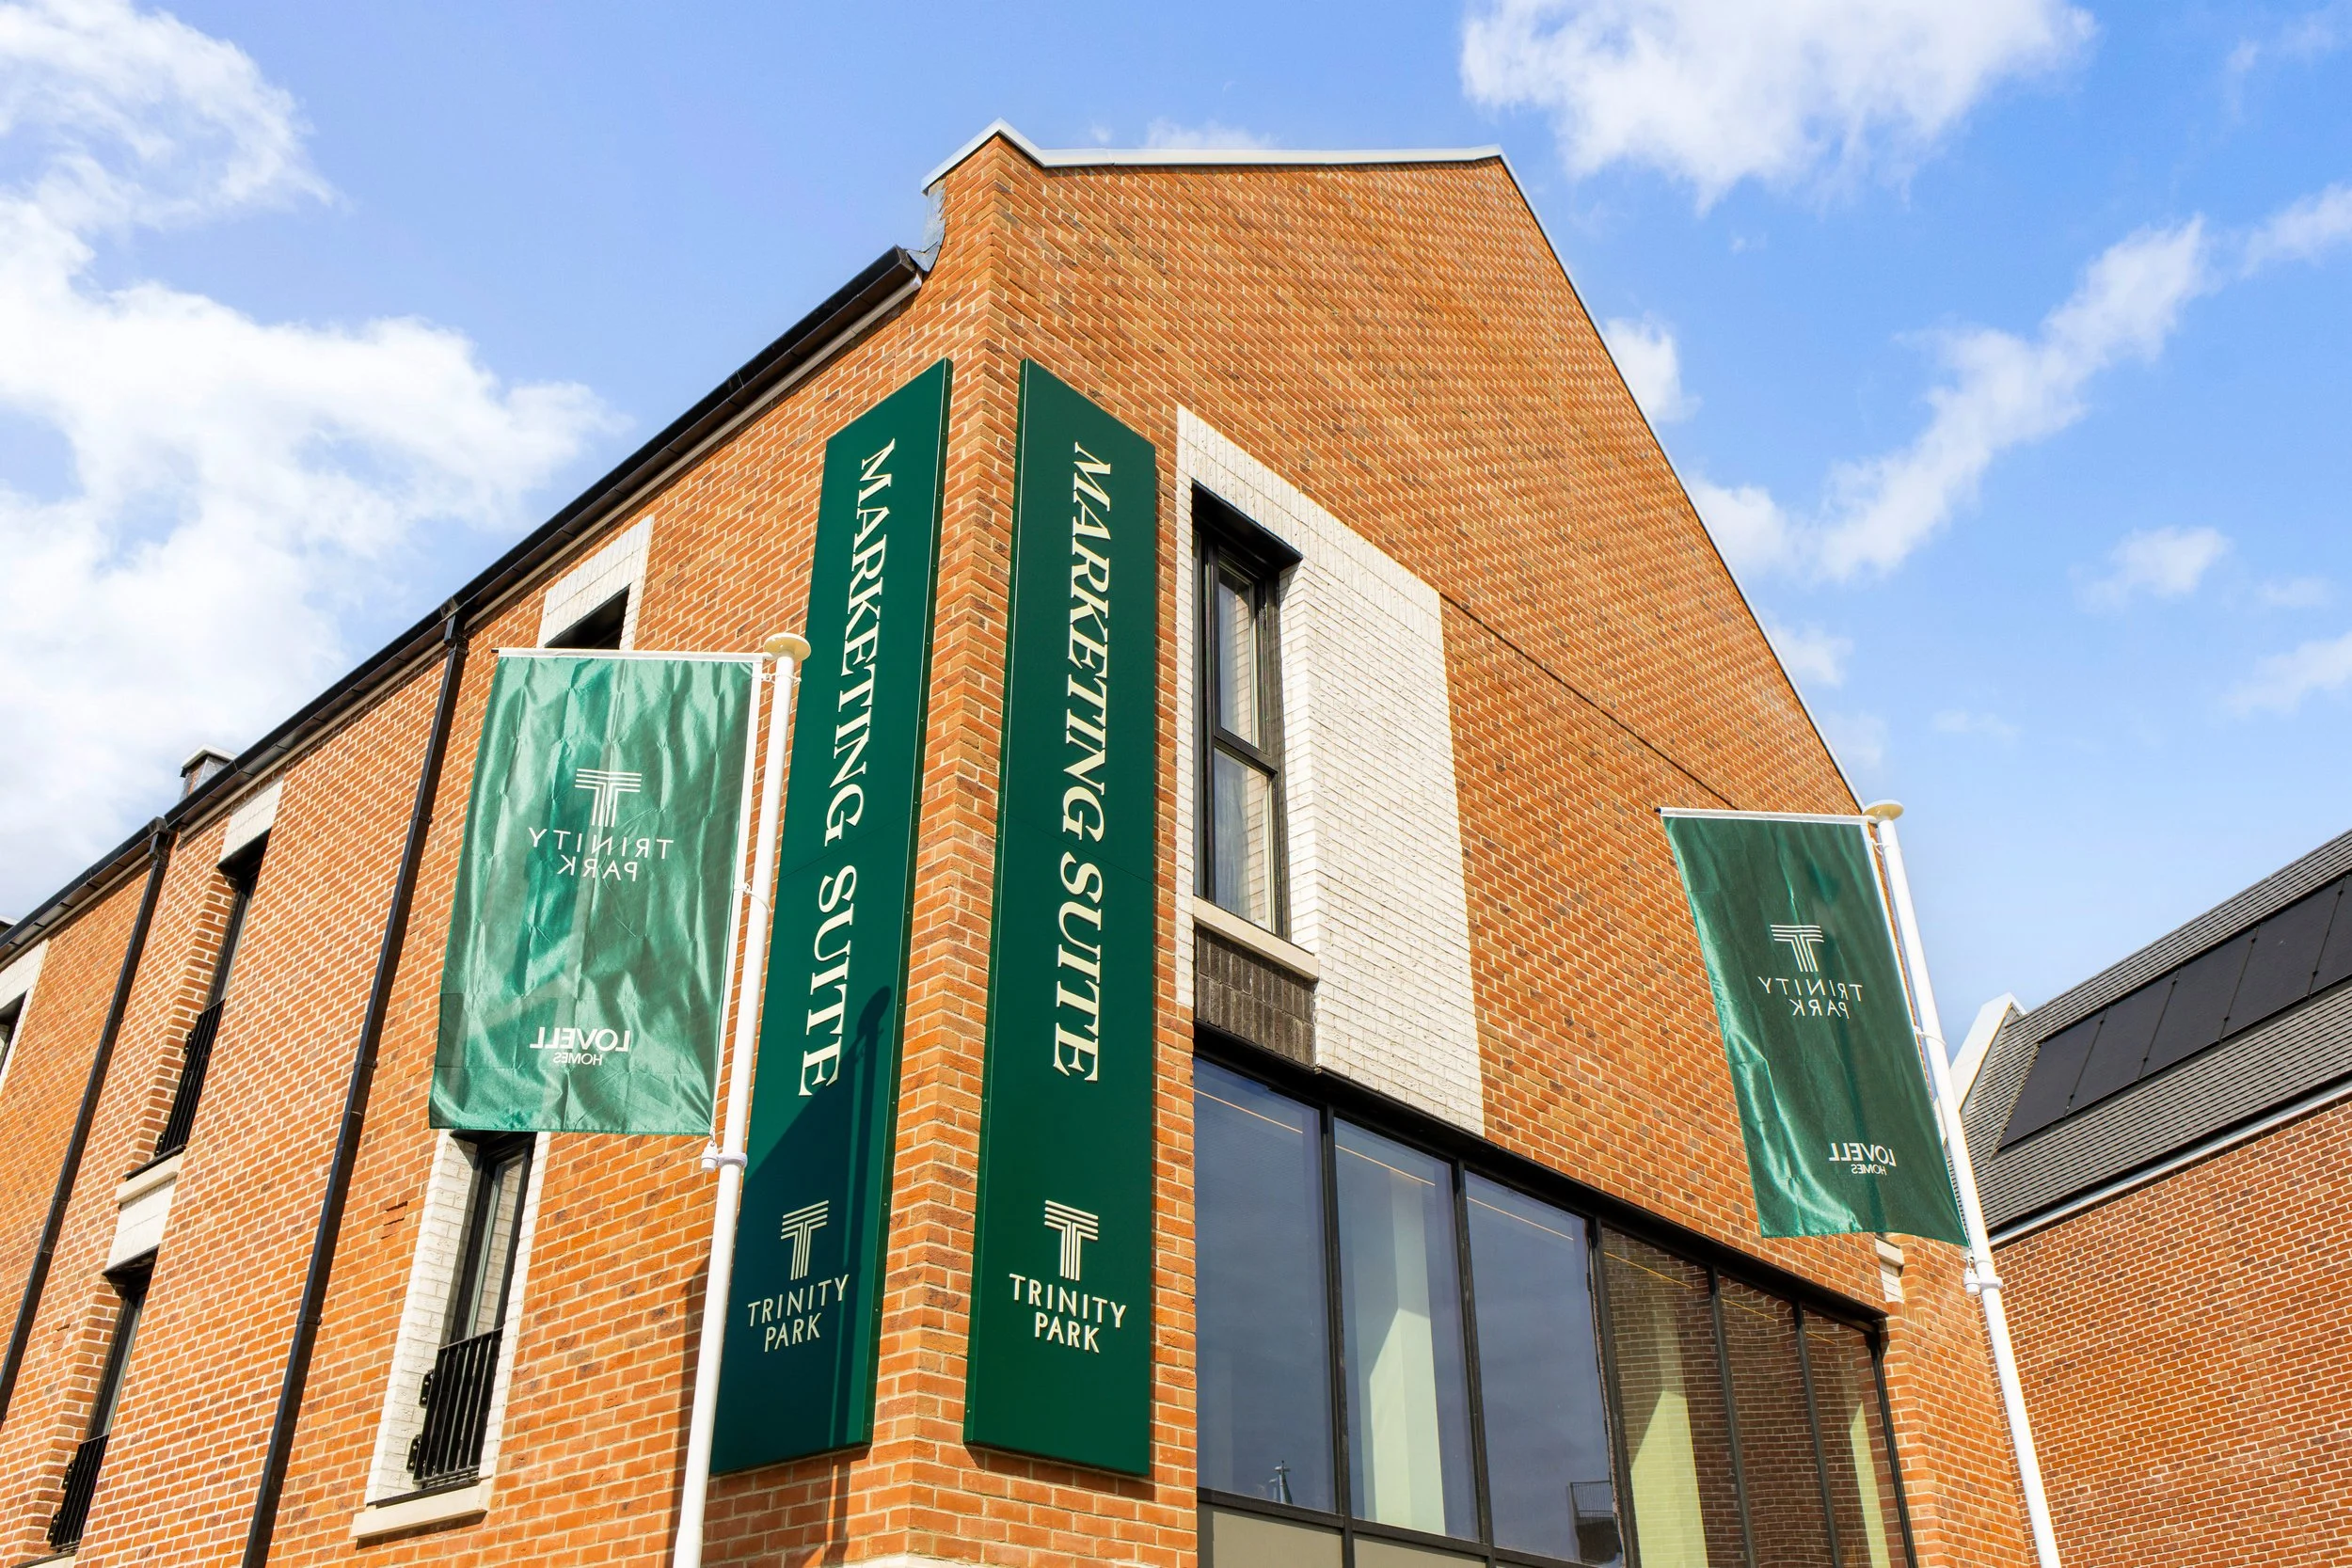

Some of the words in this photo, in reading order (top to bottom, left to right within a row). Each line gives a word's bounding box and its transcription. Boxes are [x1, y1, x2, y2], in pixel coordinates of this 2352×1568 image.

[824, 438, 896, 847] MARKETING
[1062, 441, 1112, 843] MARKETING
[799, 864, 857, 1096] SUITE
[1053, 851, 1104, 1082] SUITE
[748, 1274, 849, 1327] TRINITY
[764, 1312, 821, 1353] PARK
[1009, 1273, 1126, 1328] TRINITY
[1035, 1311, 1099, 1354] PARK
